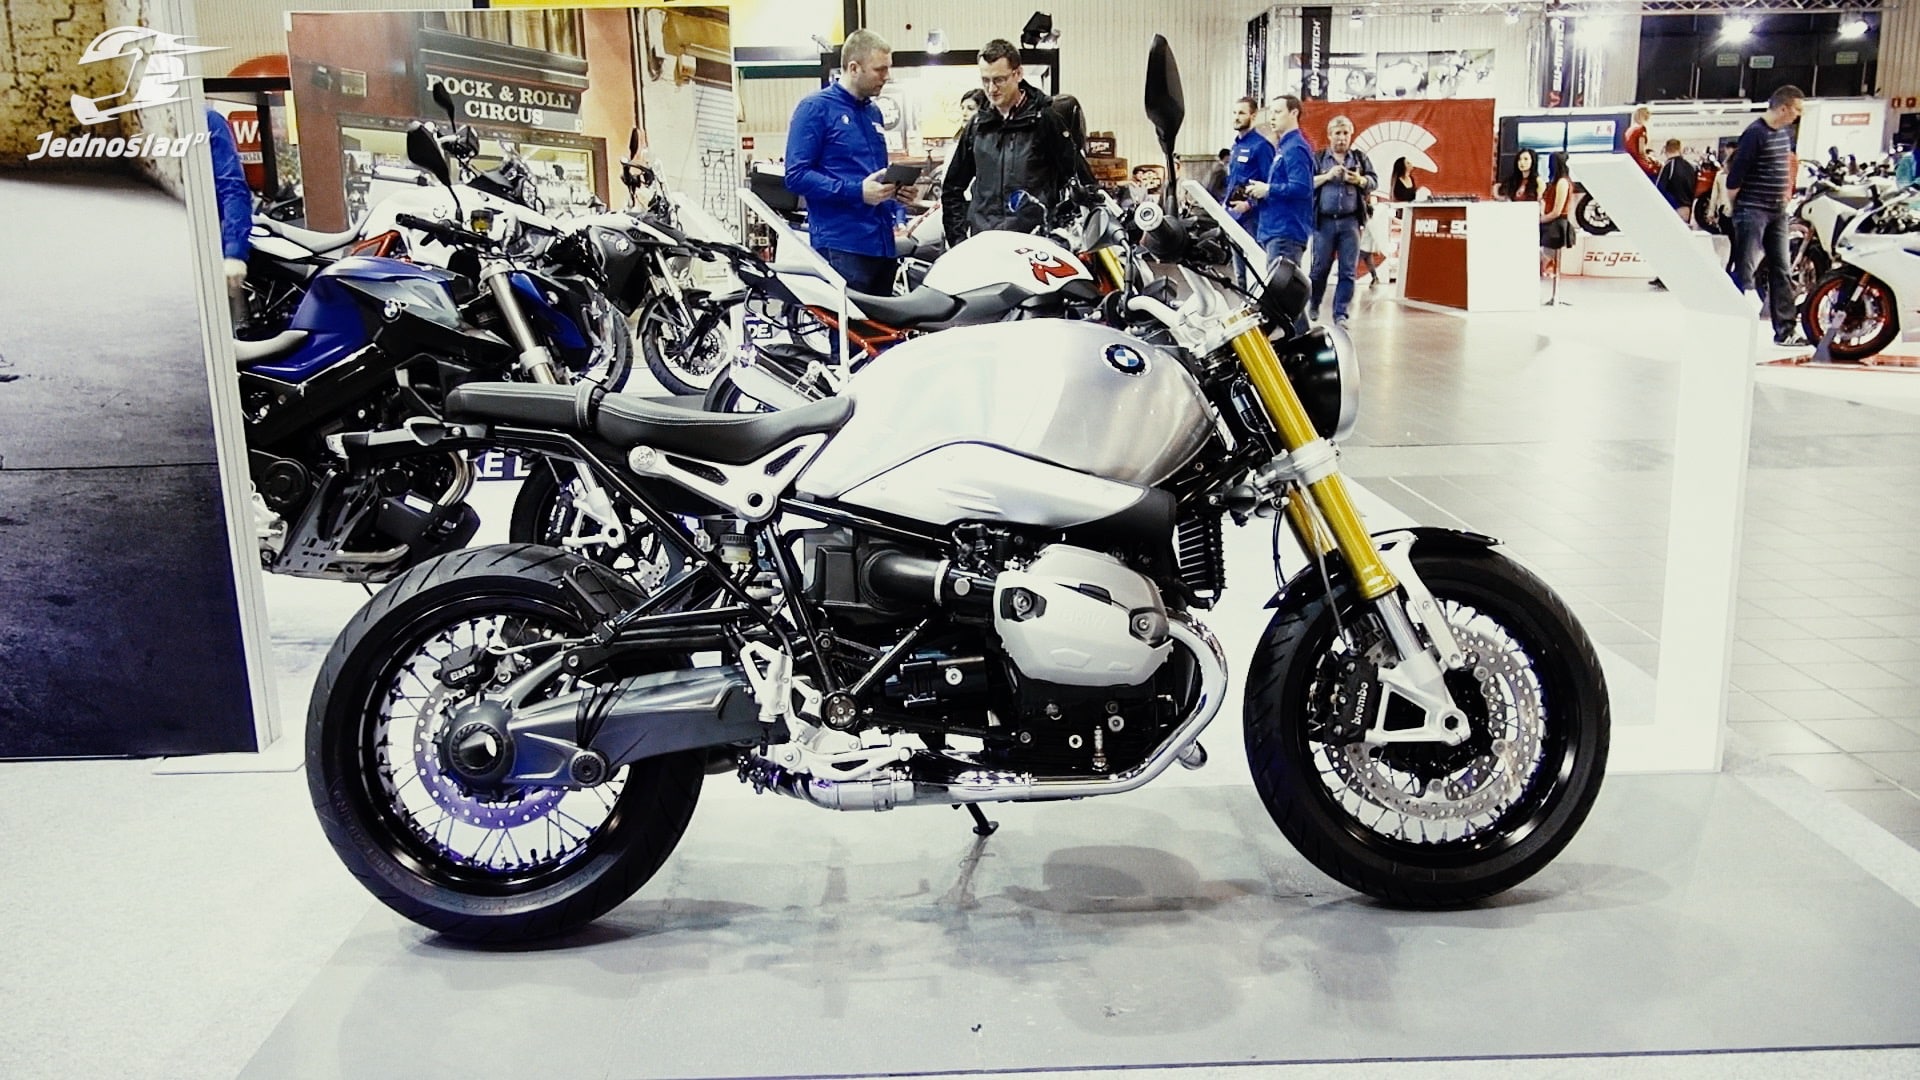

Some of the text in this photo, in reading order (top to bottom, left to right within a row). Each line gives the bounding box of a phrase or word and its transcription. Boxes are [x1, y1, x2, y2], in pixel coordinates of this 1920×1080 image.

[499, 85, 514, 102] &
[518, 87, 572, 110] ROLL
[464, 100, 544, 125] CIRCUS
[233, 120, 262, 144] W
[450, 664, 476, 682] BMW
[1350, 681, 1369, 726] brembo
